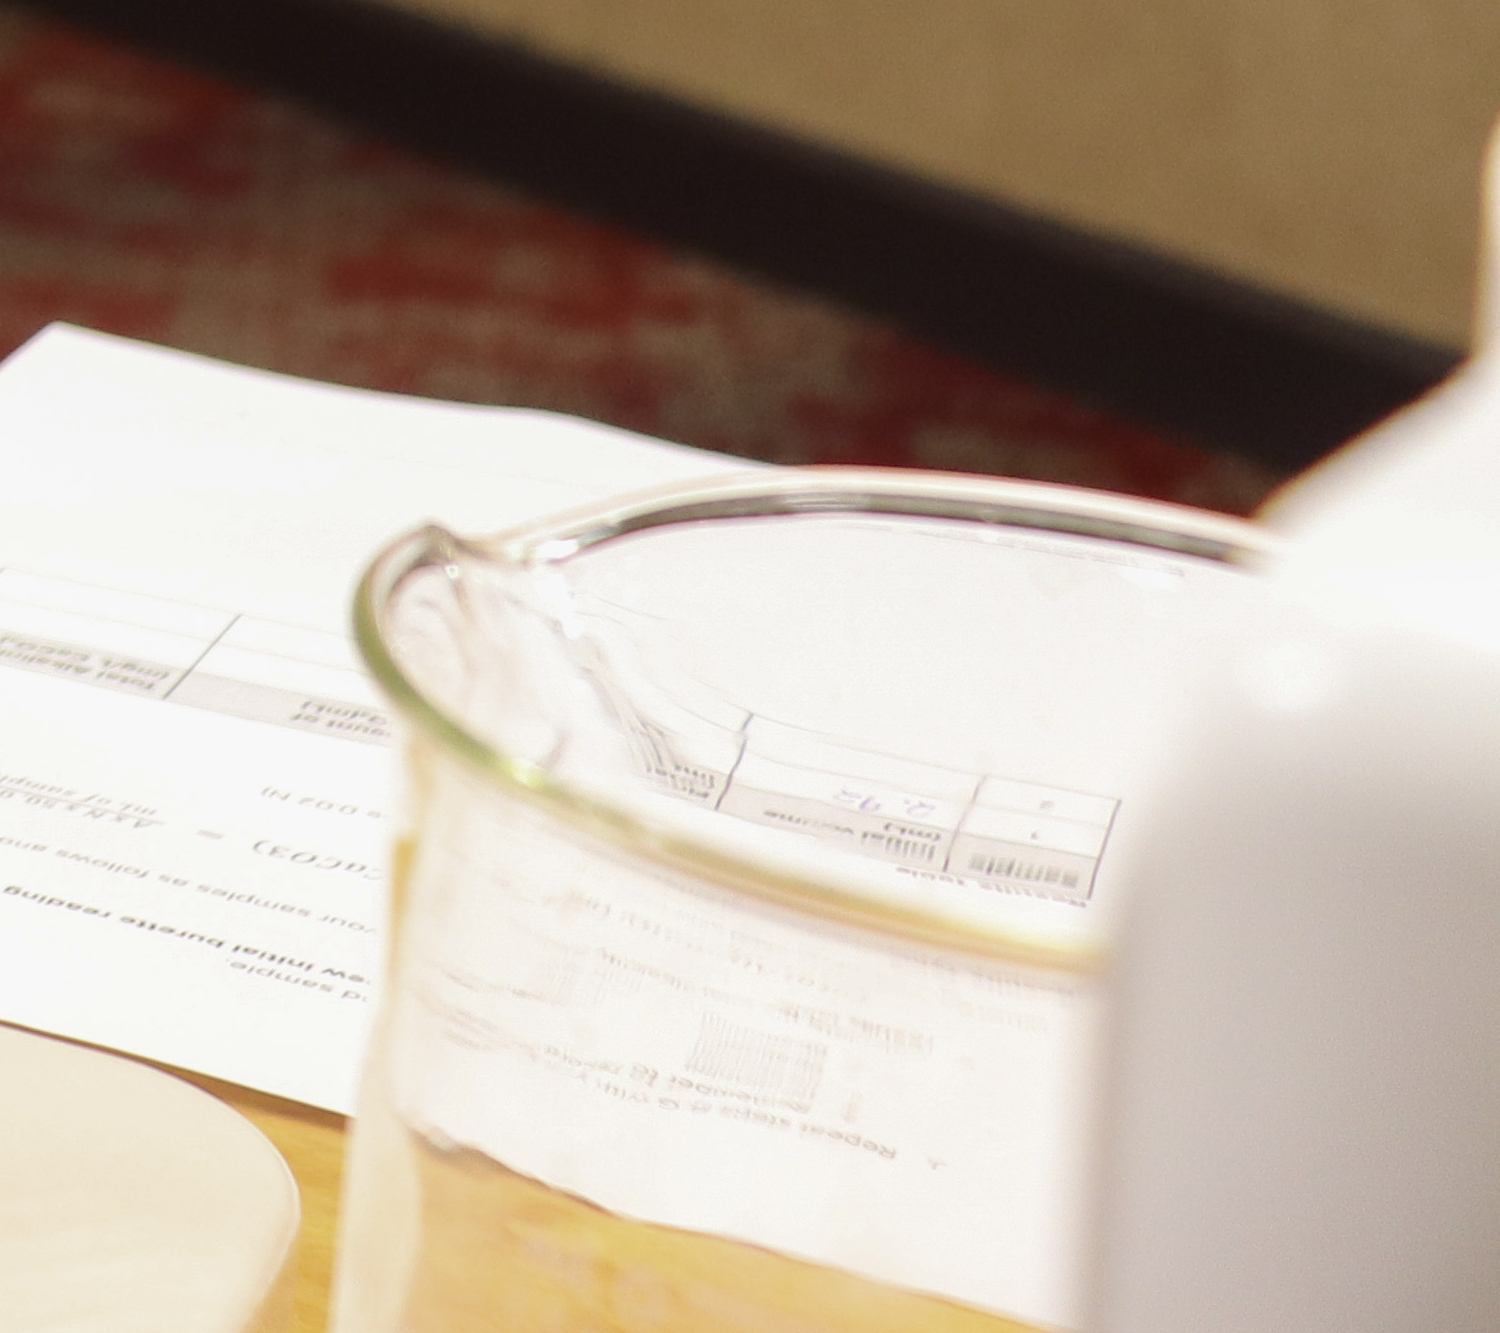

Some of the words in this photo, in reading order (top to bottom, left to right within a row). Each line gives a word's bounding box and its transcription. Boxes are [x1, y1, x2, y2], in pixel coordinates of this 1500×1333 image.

[54, 848, 151, 879] follows
[157, 873, 189, 888] as
[2, 884, 113, 920] reading
[195, 883, 313, 918] samples
[119, 915, 226, 951] burette
[231, 944, 315, 973] initial
[320, 966, 366, 985] ew
